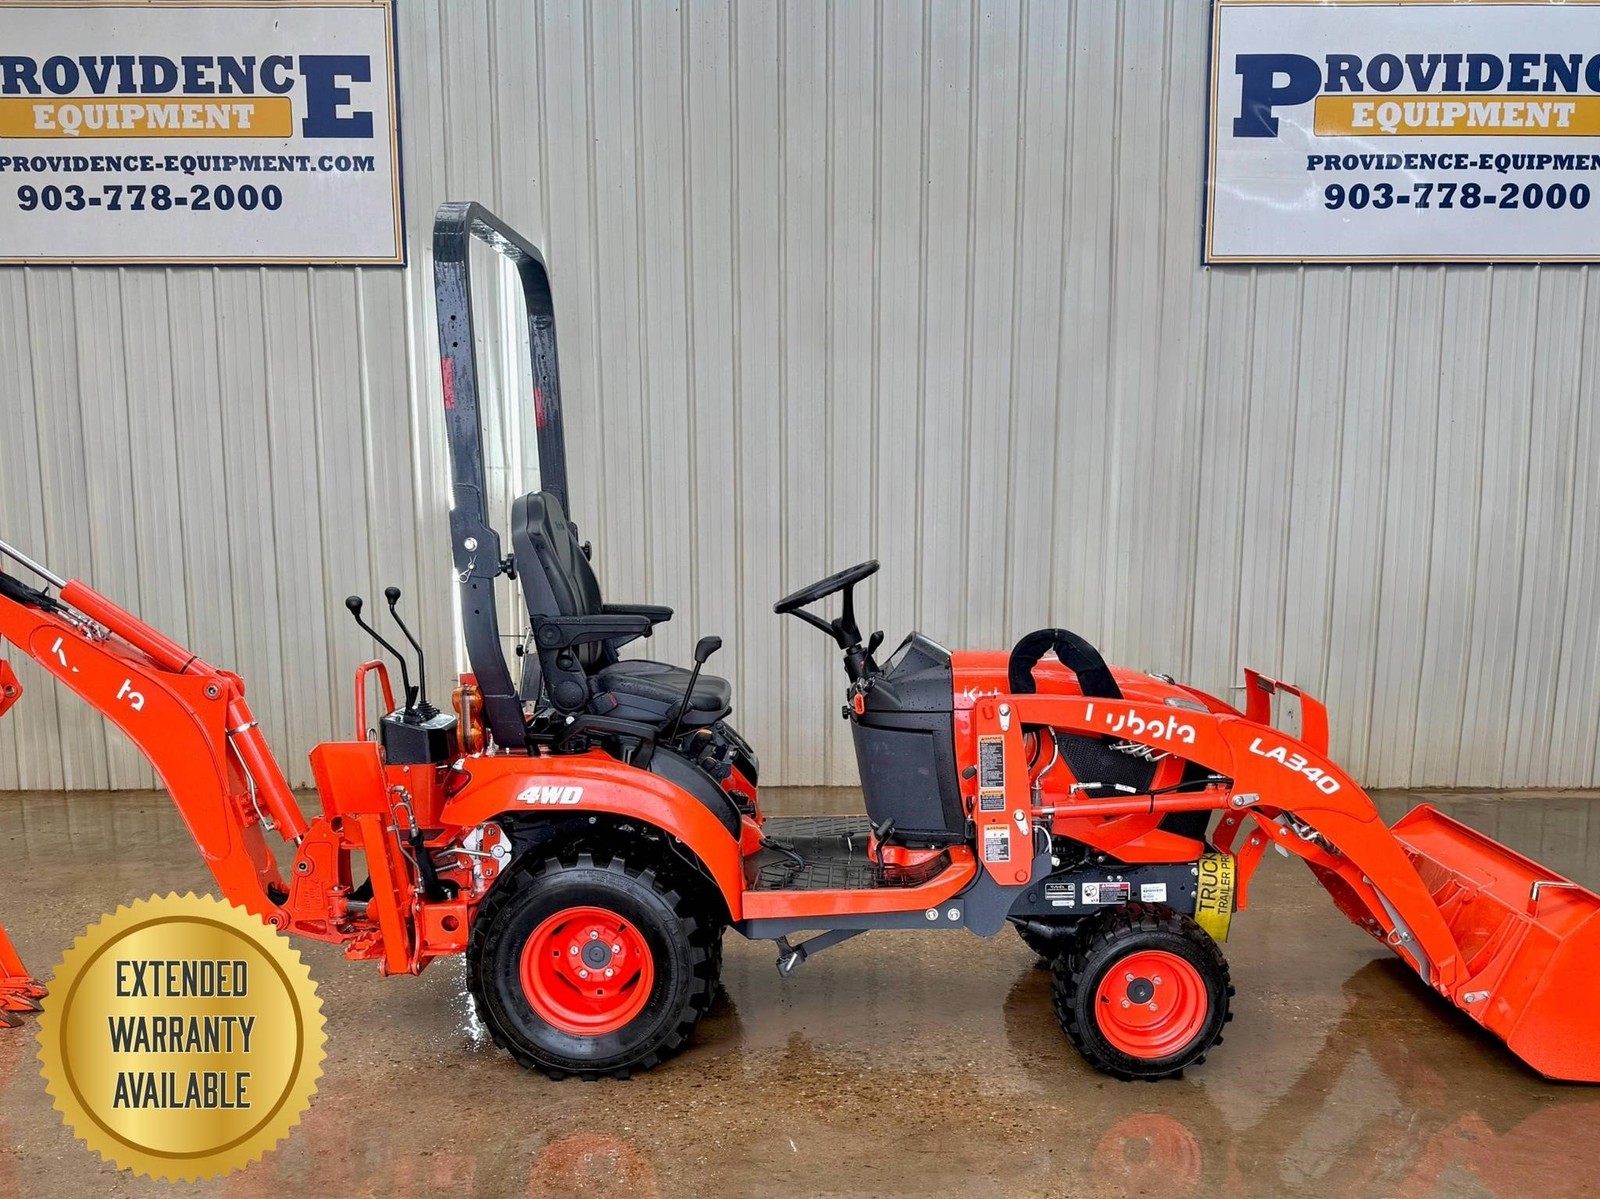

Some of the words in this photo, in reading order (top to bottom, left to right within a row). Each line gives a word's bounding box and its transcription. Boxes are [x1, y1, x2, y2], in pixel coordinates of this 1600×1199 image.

[33, 104, 255, 136] EQUIPMENT
[1351, 102, 1576, 135] EQUIPMENT
[0, 155, 375, 176] PROVIDENCE-EQUIPMENT.COM
[17, 184, 283, 212] 903-778-2000
[1324, 183, 1591, 210] 903-778-2000
[1249, 737, 1341, 794] LA340
[516, 786, 584, 805] 4WD
[1220, 854, 1231, 869] PR
[1199, 853, 1219, 912] TRUCK
[1217, 871, 1231, 915] TRAILER
